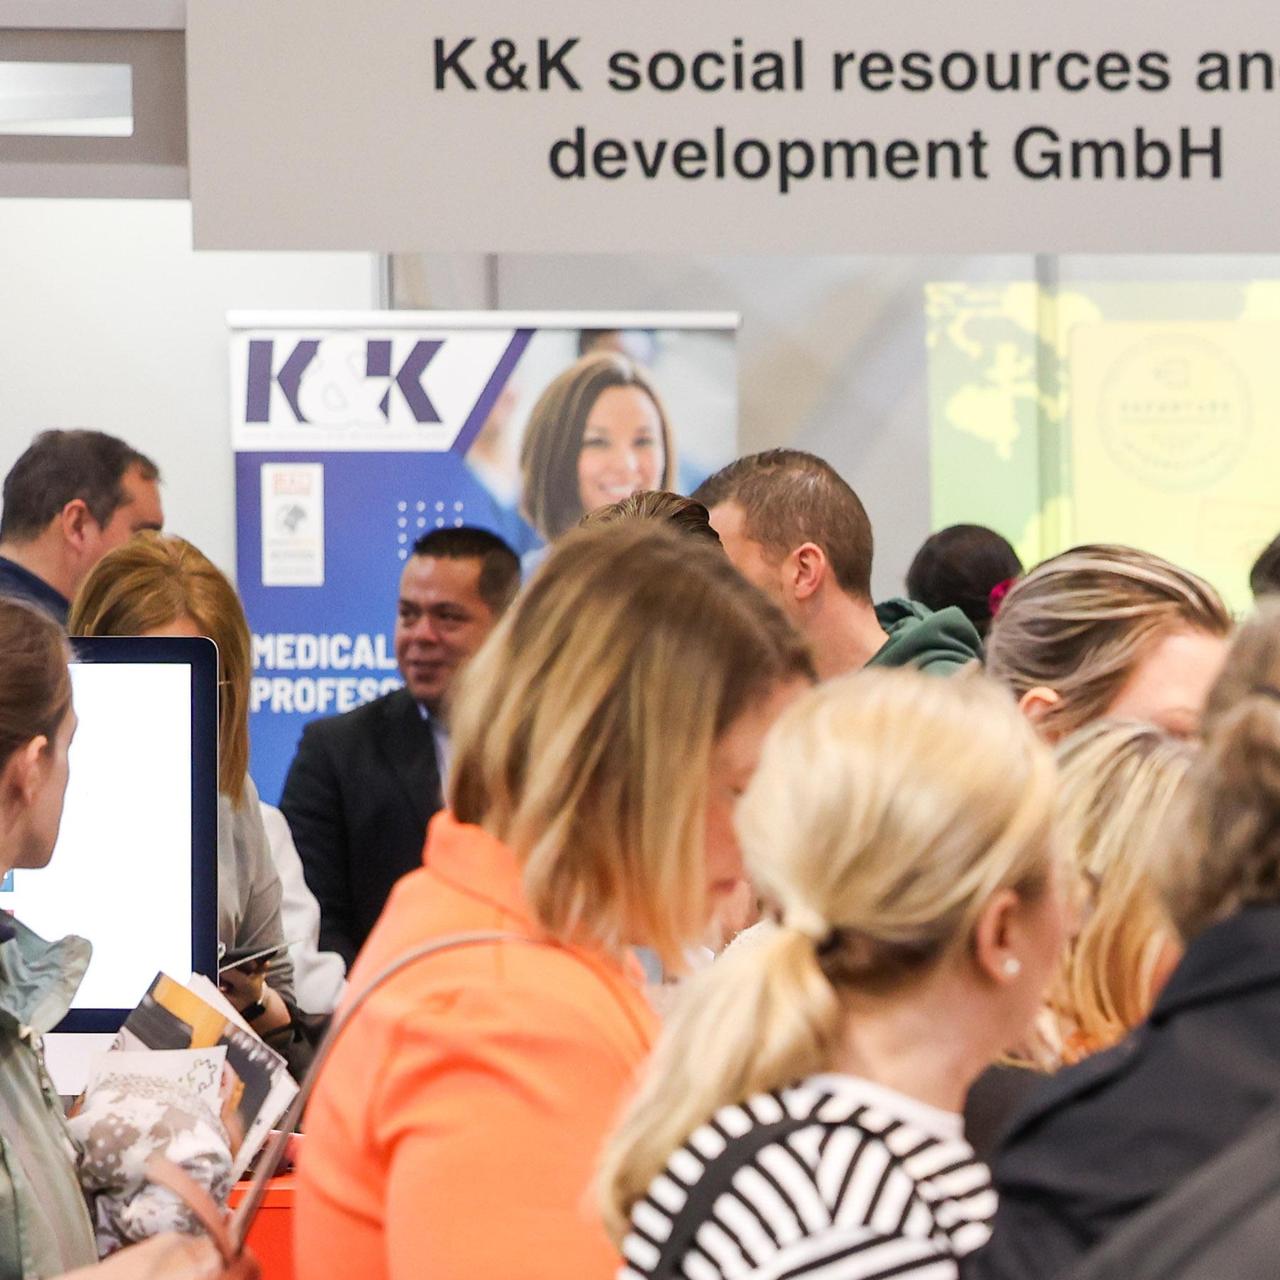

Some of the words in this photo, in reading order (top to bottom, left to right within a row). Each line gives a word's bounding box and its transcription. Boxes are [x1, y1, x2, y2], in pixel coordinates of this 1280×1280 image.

[434, 38, 582, 92] K&K
[608, 38, 804, 92] social
[833, 50, 1170, 92] resources
[549, 126, 988, 194] development
[1014, 126, 1222, 180] GmbH
[245, 340, 447, 424] K&K
[251, 633, 397, 670] MEDICAL
